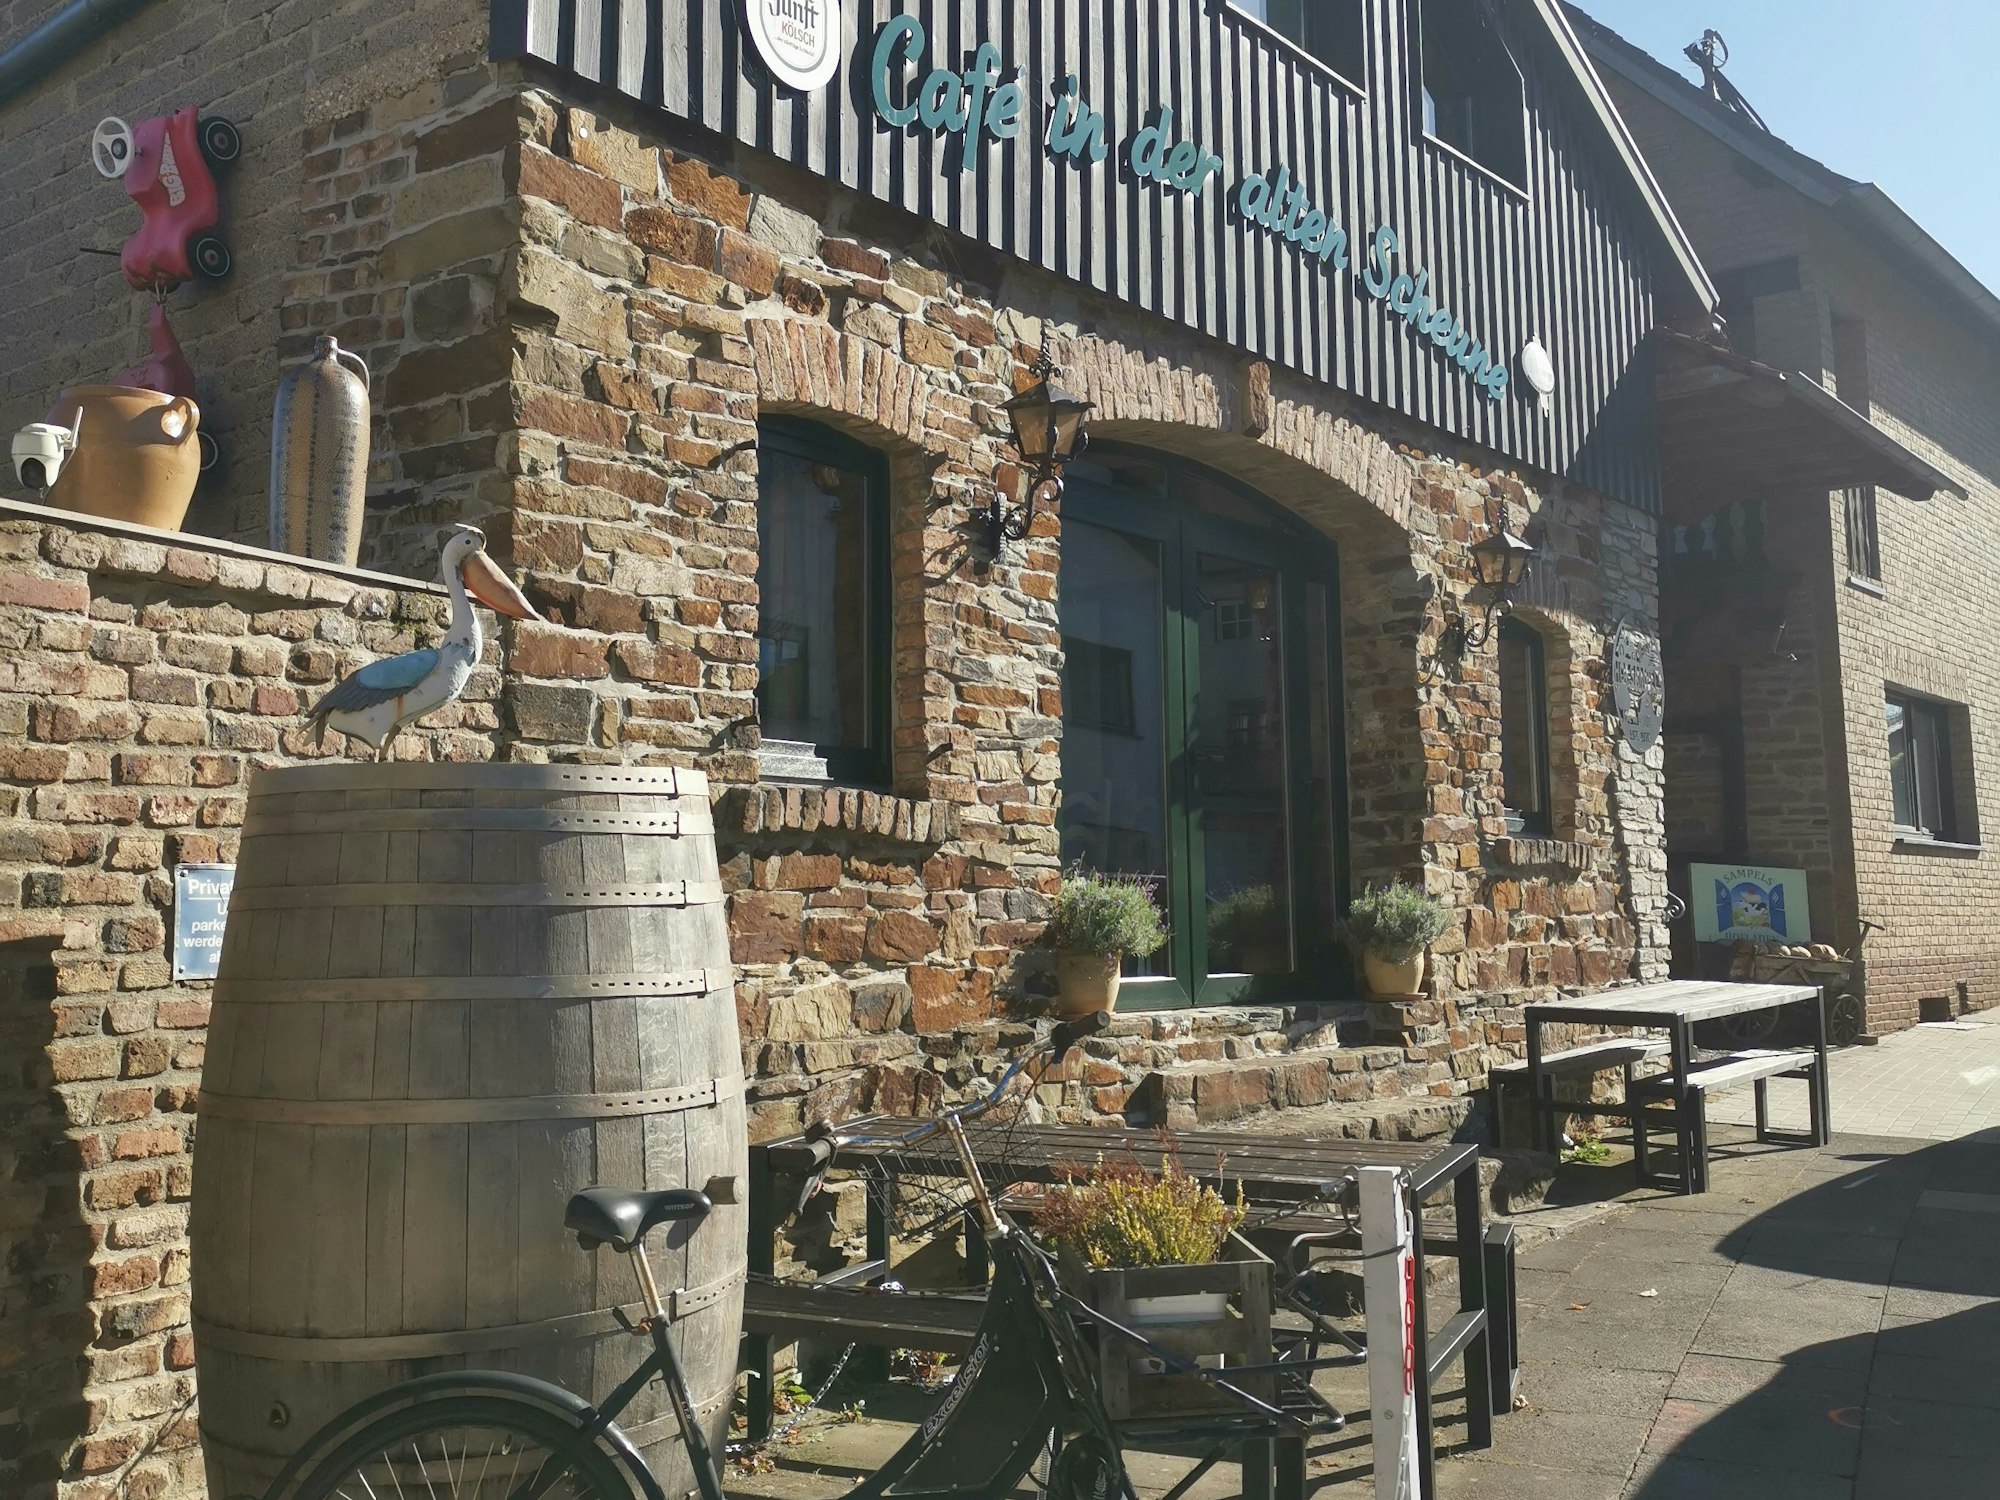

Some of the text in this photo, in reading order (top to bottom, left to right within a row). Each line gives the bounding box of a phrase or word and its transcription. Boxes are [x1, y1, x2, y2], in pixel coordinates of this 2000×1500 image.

[781, 20, 815, 48] KÖLSCH
[872, 14, 1510, 401] Café in der alten Scheune
[1723, 868, 1775, 887] SAMPELS
[921, 1332, 990, 1445] Excelsior
